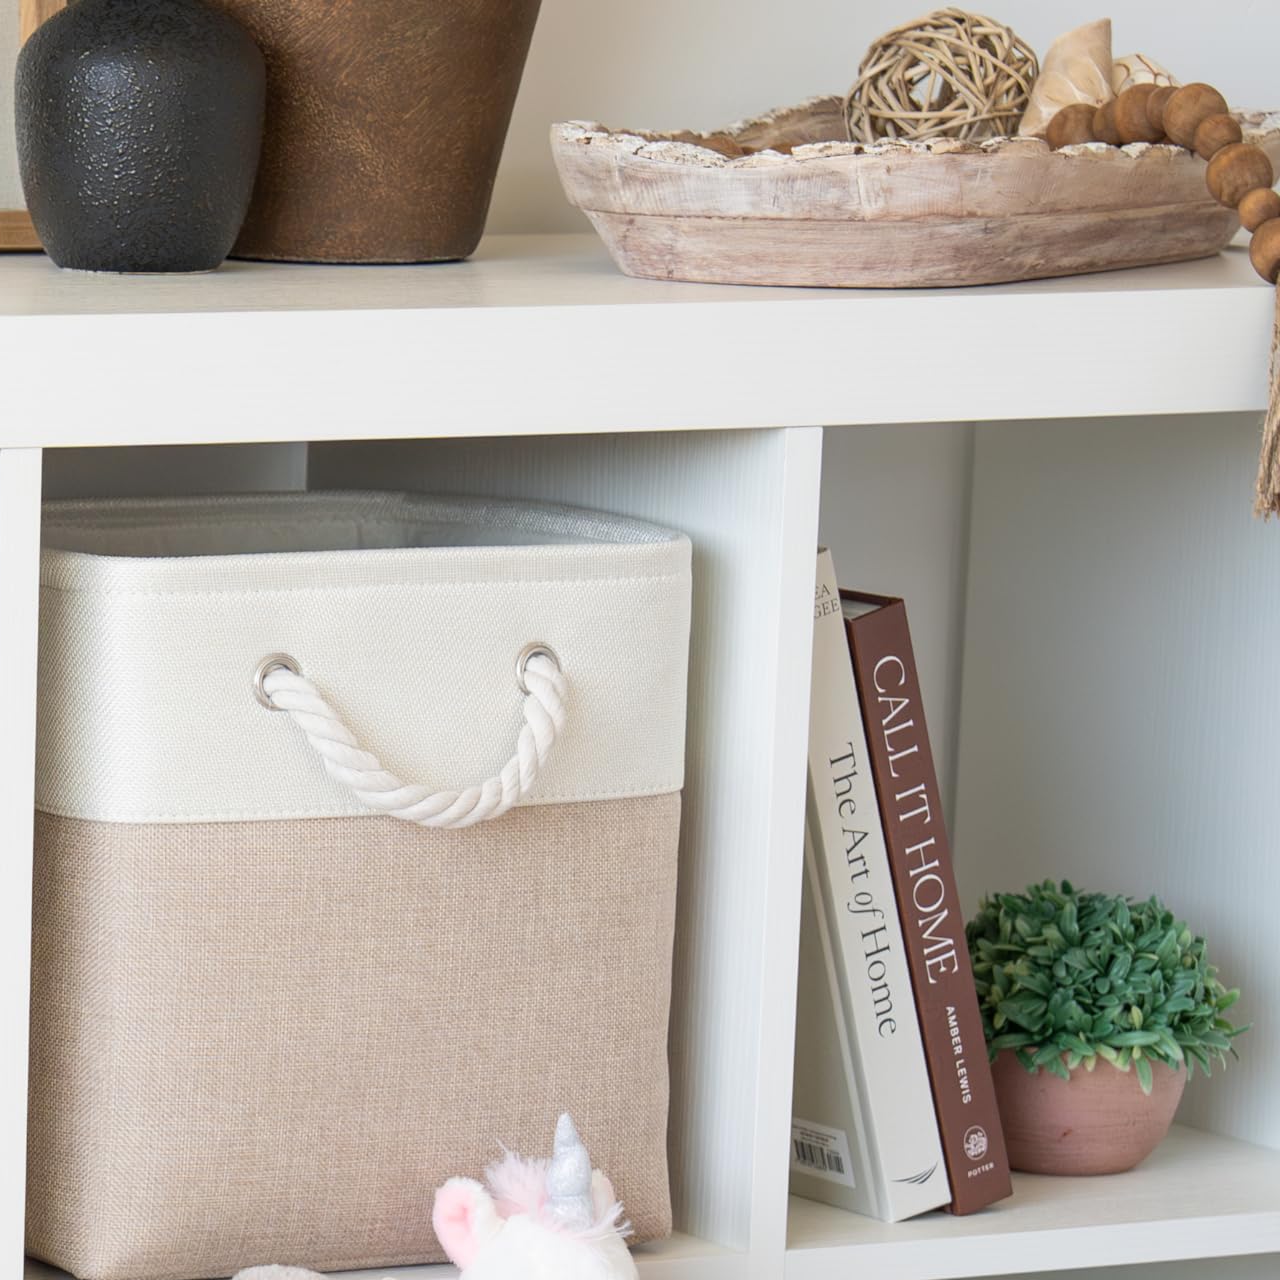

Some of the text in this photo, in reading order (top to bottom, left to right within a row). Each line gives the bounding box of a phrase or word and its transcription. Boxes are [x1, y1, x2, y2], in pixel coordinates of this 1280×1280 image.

[829, 742, 897, 1039] The Art of Home
[873, 655, 959, 984] CALL IT HOME
[945, 1005, 972, 1104] AMBER LEWIS
